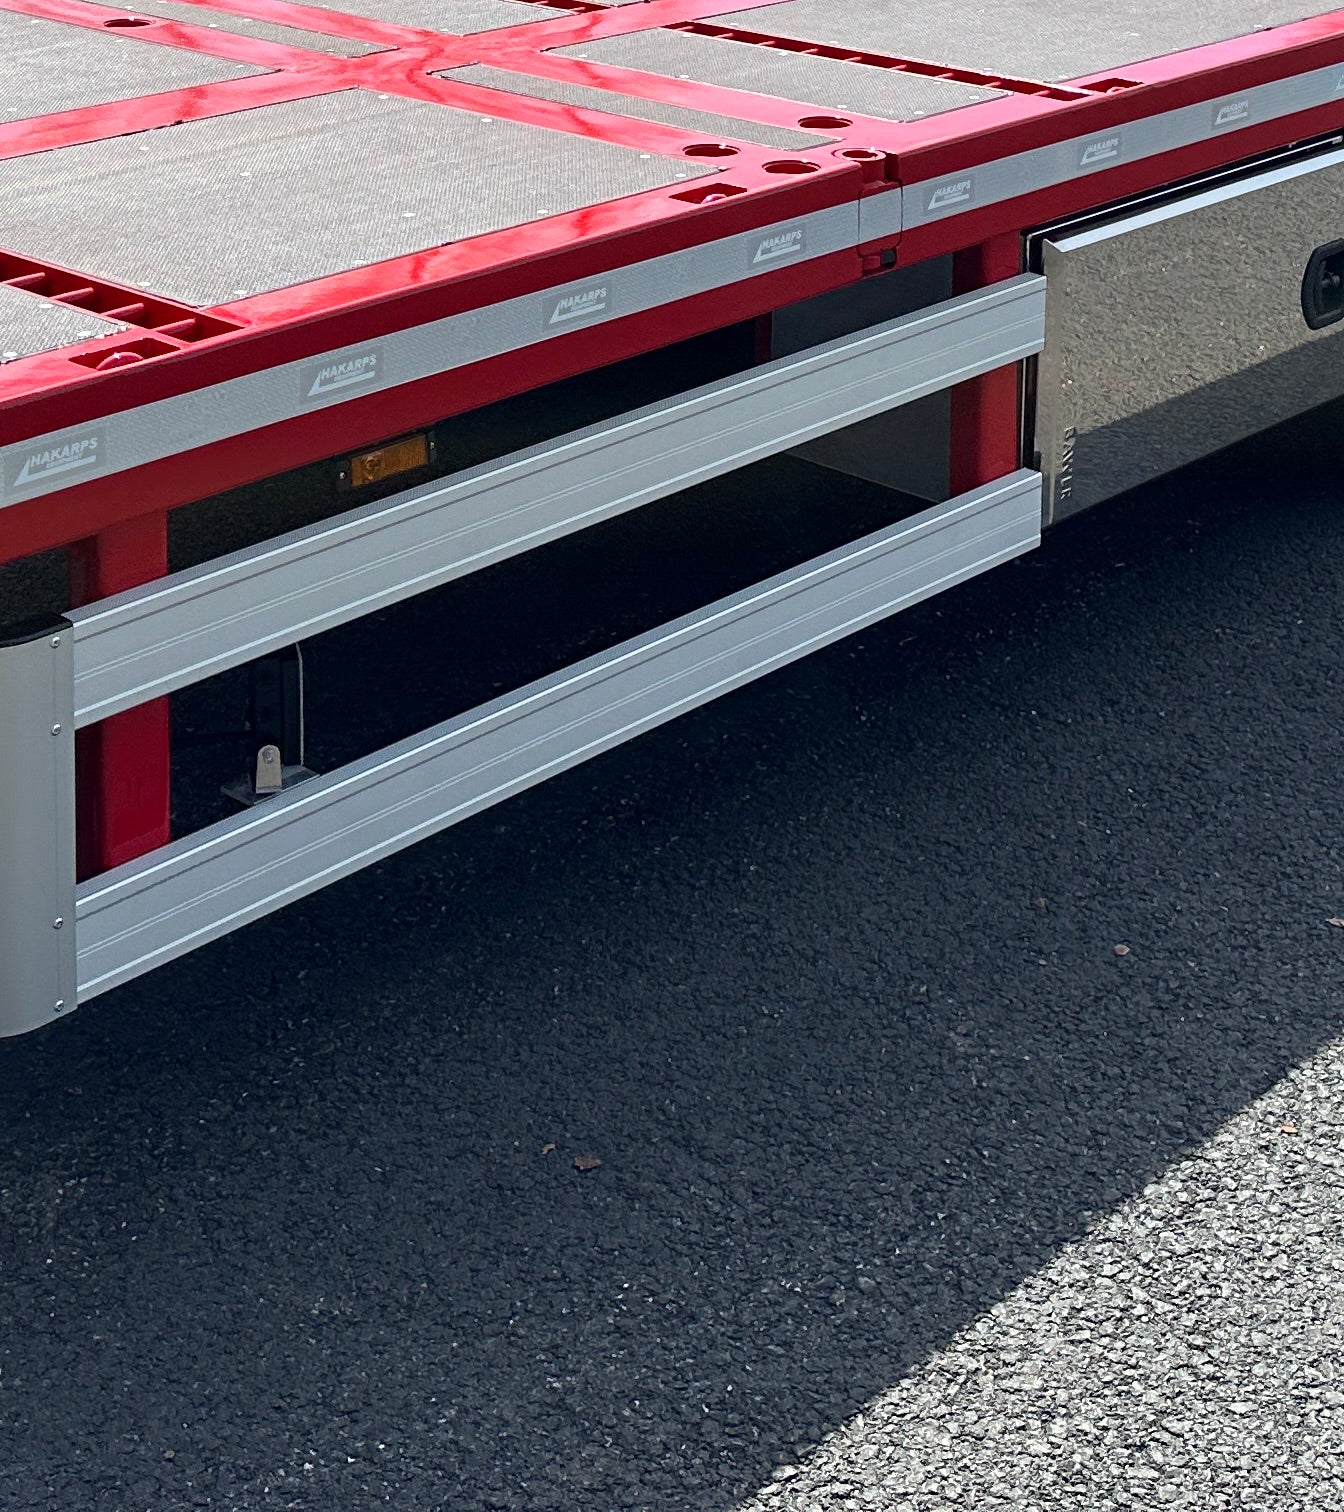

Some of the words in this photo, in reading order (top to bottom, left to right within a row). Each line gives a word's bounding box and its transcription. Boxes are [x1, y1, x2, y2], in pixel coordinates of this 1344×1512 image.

[559, 287, 607, 310] HAKARPS
[320, 354, 377, 380] HAKARPS
[29, 437, 98, 468] HAKARPS
